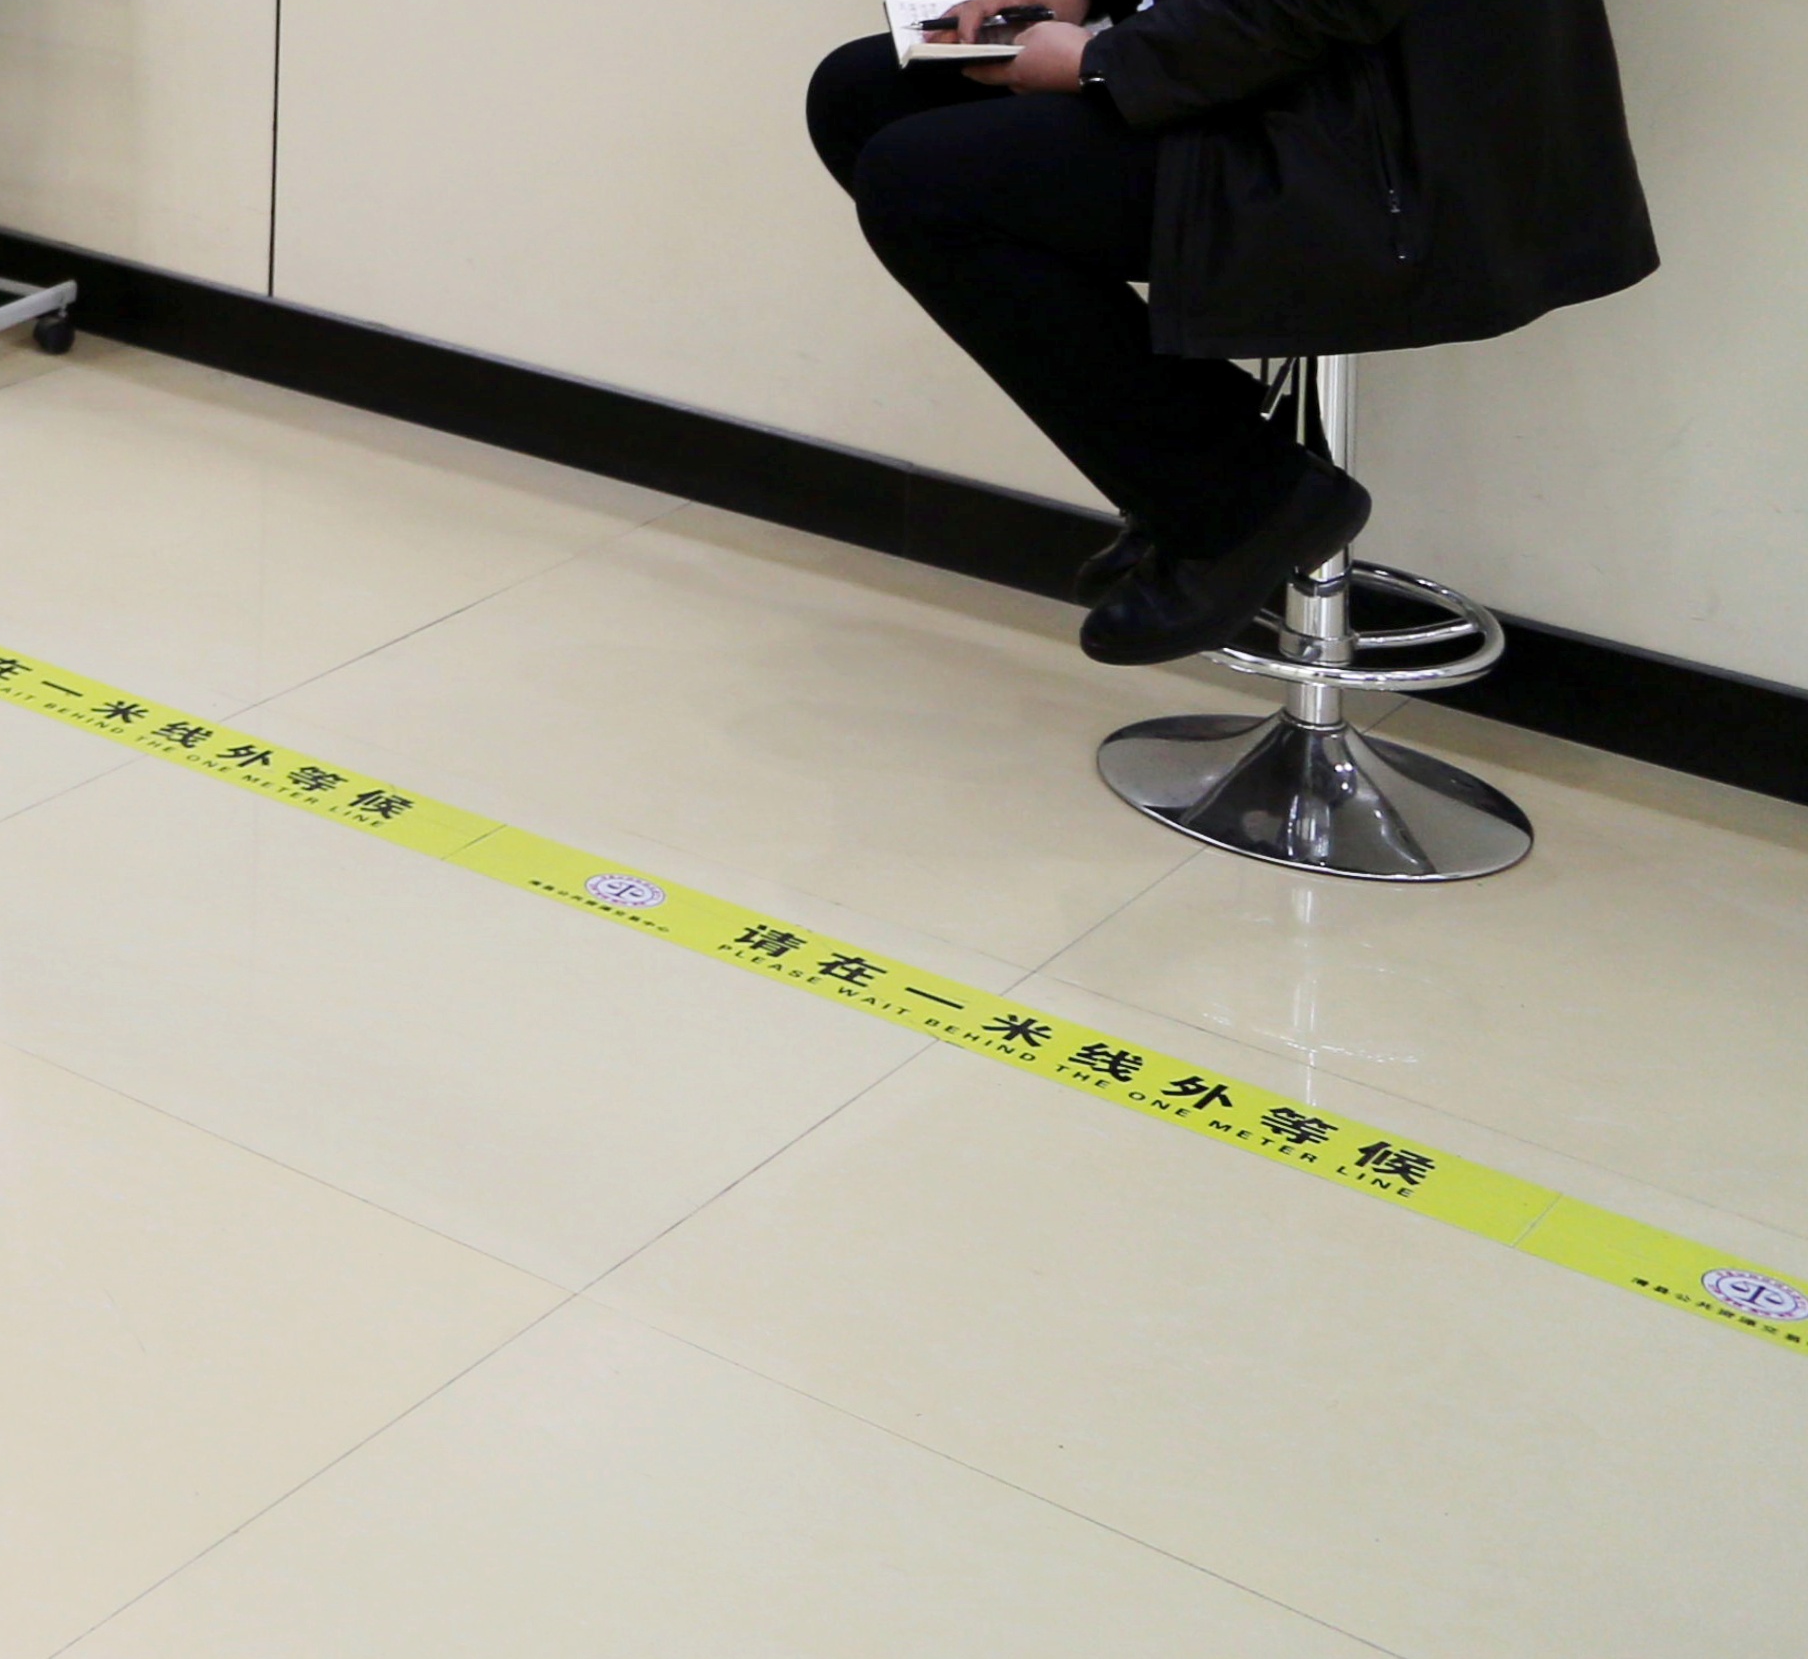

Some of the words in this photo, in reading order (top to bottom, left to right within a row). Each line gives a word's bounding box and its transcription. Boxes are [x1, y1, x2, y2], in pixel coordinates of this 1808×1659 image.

[44, 703, 124, 733] BEHIND
[136, 736, 175, 752] THE
[187, 755, 230, 772] ONE
[242, 775, 318, 804] METER
[330, 807, 381, 826] LINE
[718, 945, 820, 982] PLEASE
[838, 987, 908, 1014] WAIT
[925, 1019, 1035, 1061] BEHIND
[1057, 1065, 1109, 1086] THE
[1129, 1092, 1189, 1116] ONE
[1209, 1120, 1317, 1162] METER
[1337, 1166, 1411, 1197] LINE
[735, 925, 1435, 1185] 请在一米线外等候
